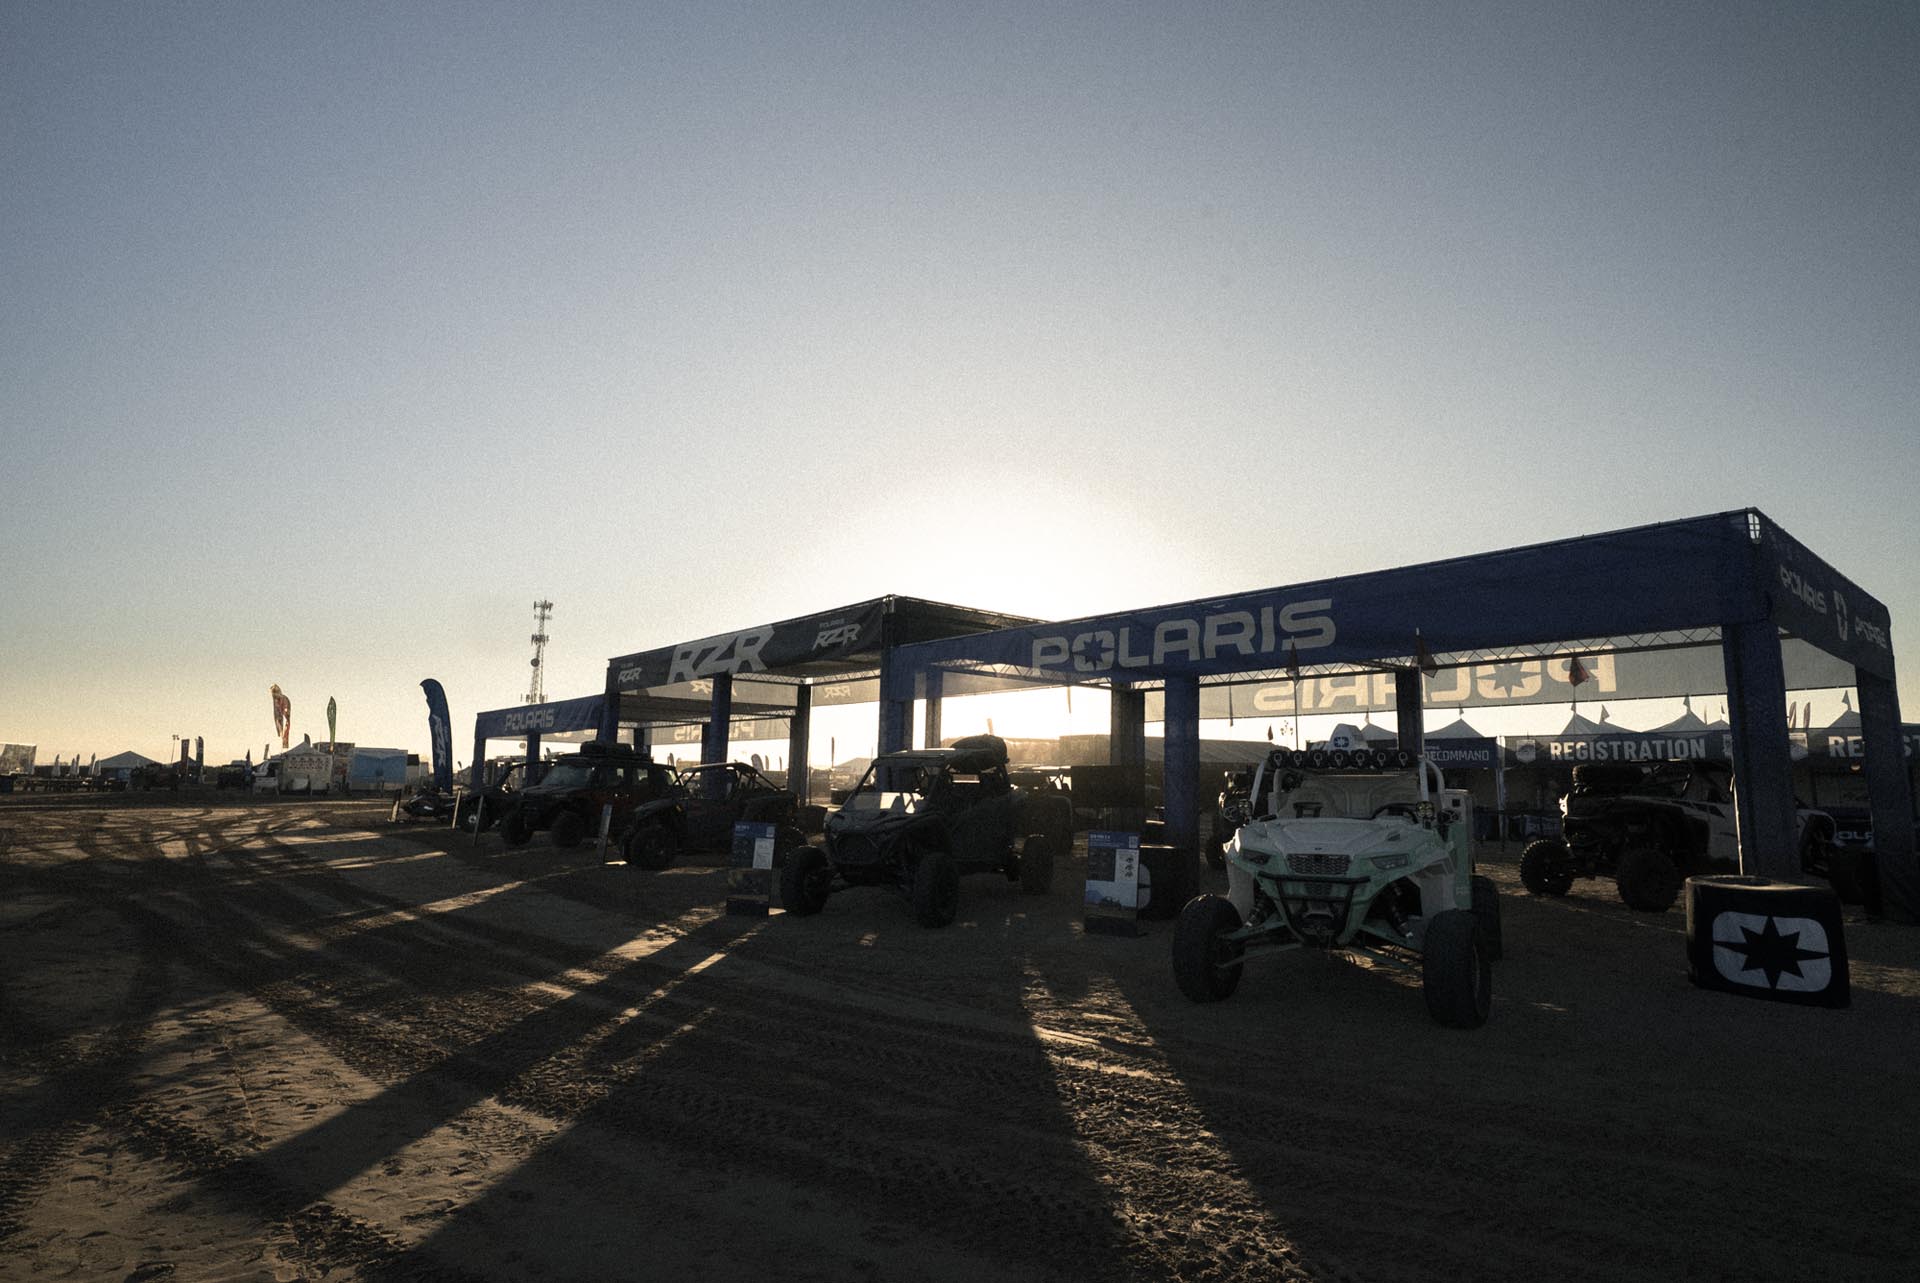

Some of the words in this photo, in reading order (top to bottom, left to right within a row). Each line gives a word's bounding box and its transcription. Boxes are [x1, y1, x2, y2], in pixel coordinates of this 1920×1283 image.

[812, 623, 862, 651] RZR
[1032, 598, 1337, 676] POLARIS
[667, 625, 776, 685] RZR
[617, 667, 643, 689] RZR
[504, 709, 554, 732] POLARIS
[1550, 738, 1706, 761] REGISTRATION
